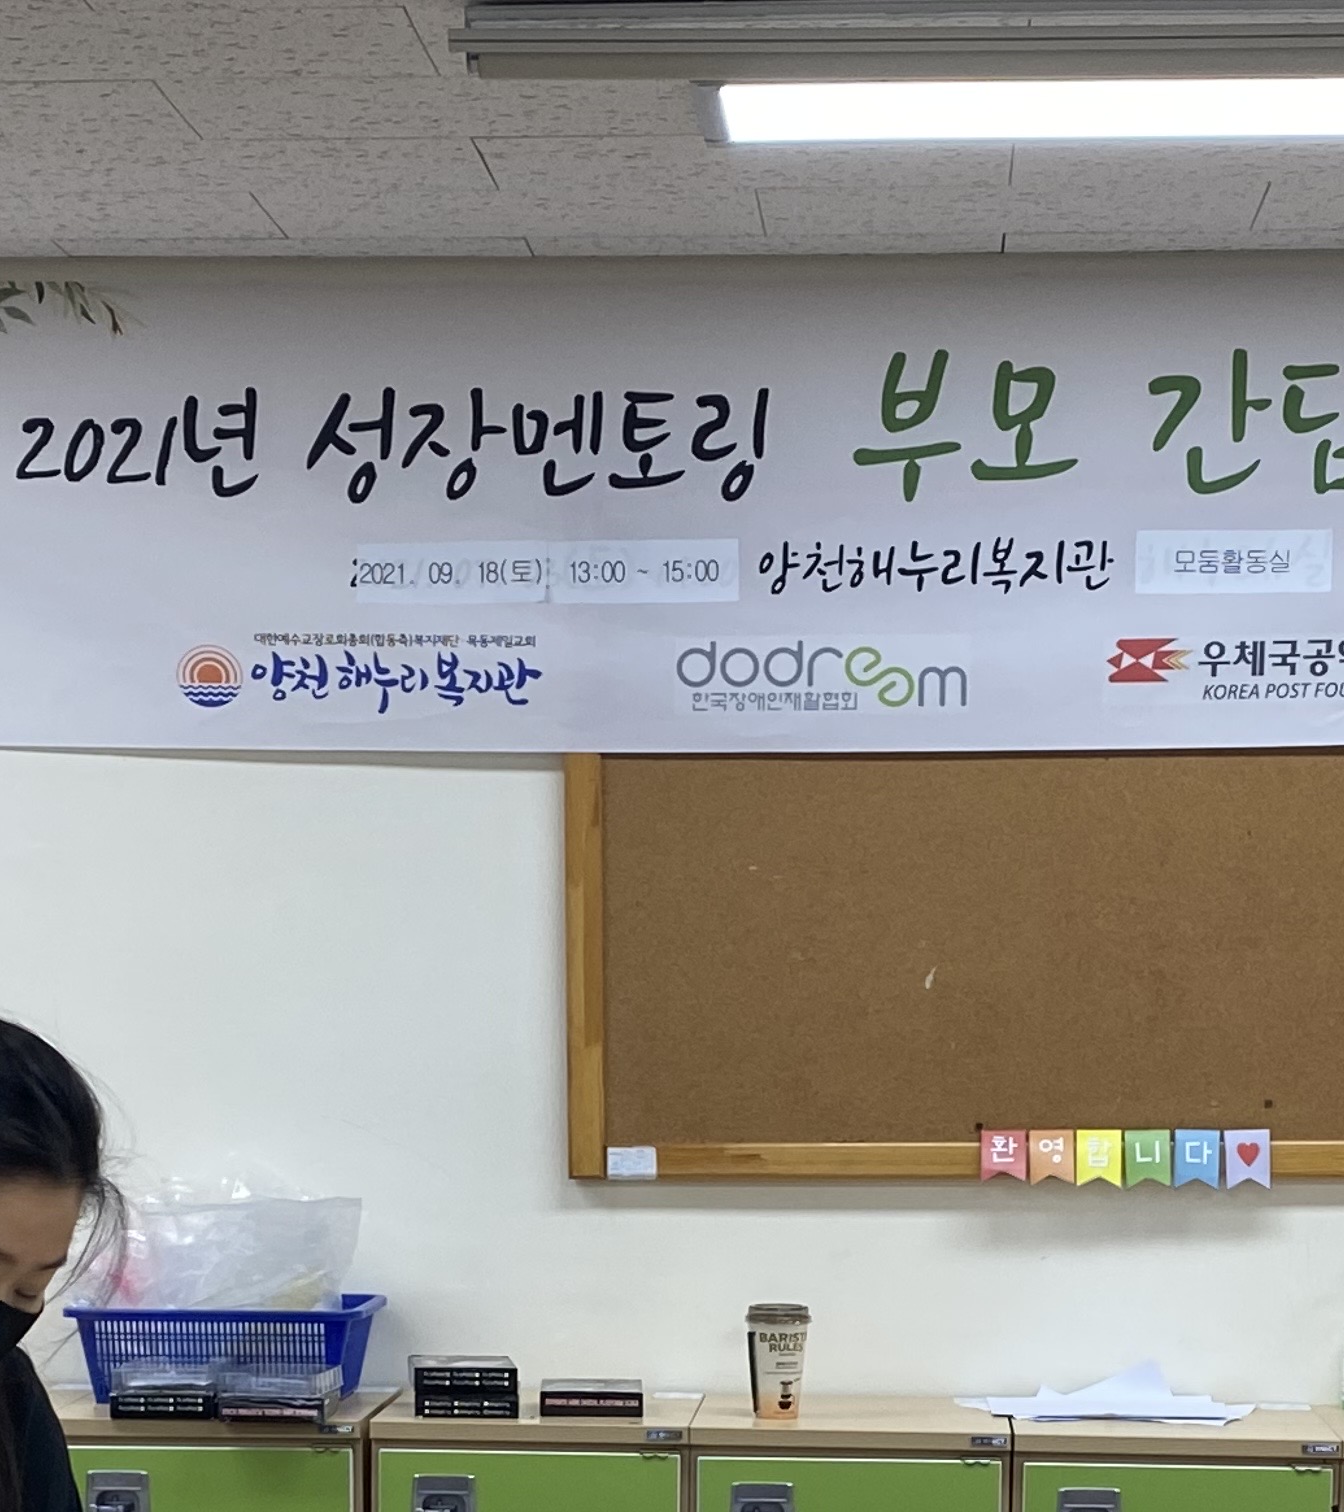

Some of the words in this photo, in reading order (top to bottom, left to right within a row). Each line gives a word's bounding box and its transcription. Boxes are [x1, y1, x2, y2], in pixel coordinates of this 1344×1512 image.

[15, 386, 259, 498] 2021년
[306, 386, 770, 504] 성장멘토링
[852, 348, 1079, 503] 부모
[359, 562, 414, 586] 2021.
[428, 561, 460, 585] 09.
[478, 558, 543, 586] 18(토)
[570, 560, 626, 584] 13:00
[662, 559, 720, 583] 15:00
[758, 536, 1115, 595] 양천해누리복지관
[1174, 549, 1291, 574] 모둠활동실
[692, 691, 858, 712] 한국장애인재활협회
[1202, 683, 1260, 701] KOREA
[1264, 682, 1312, 699] POST
